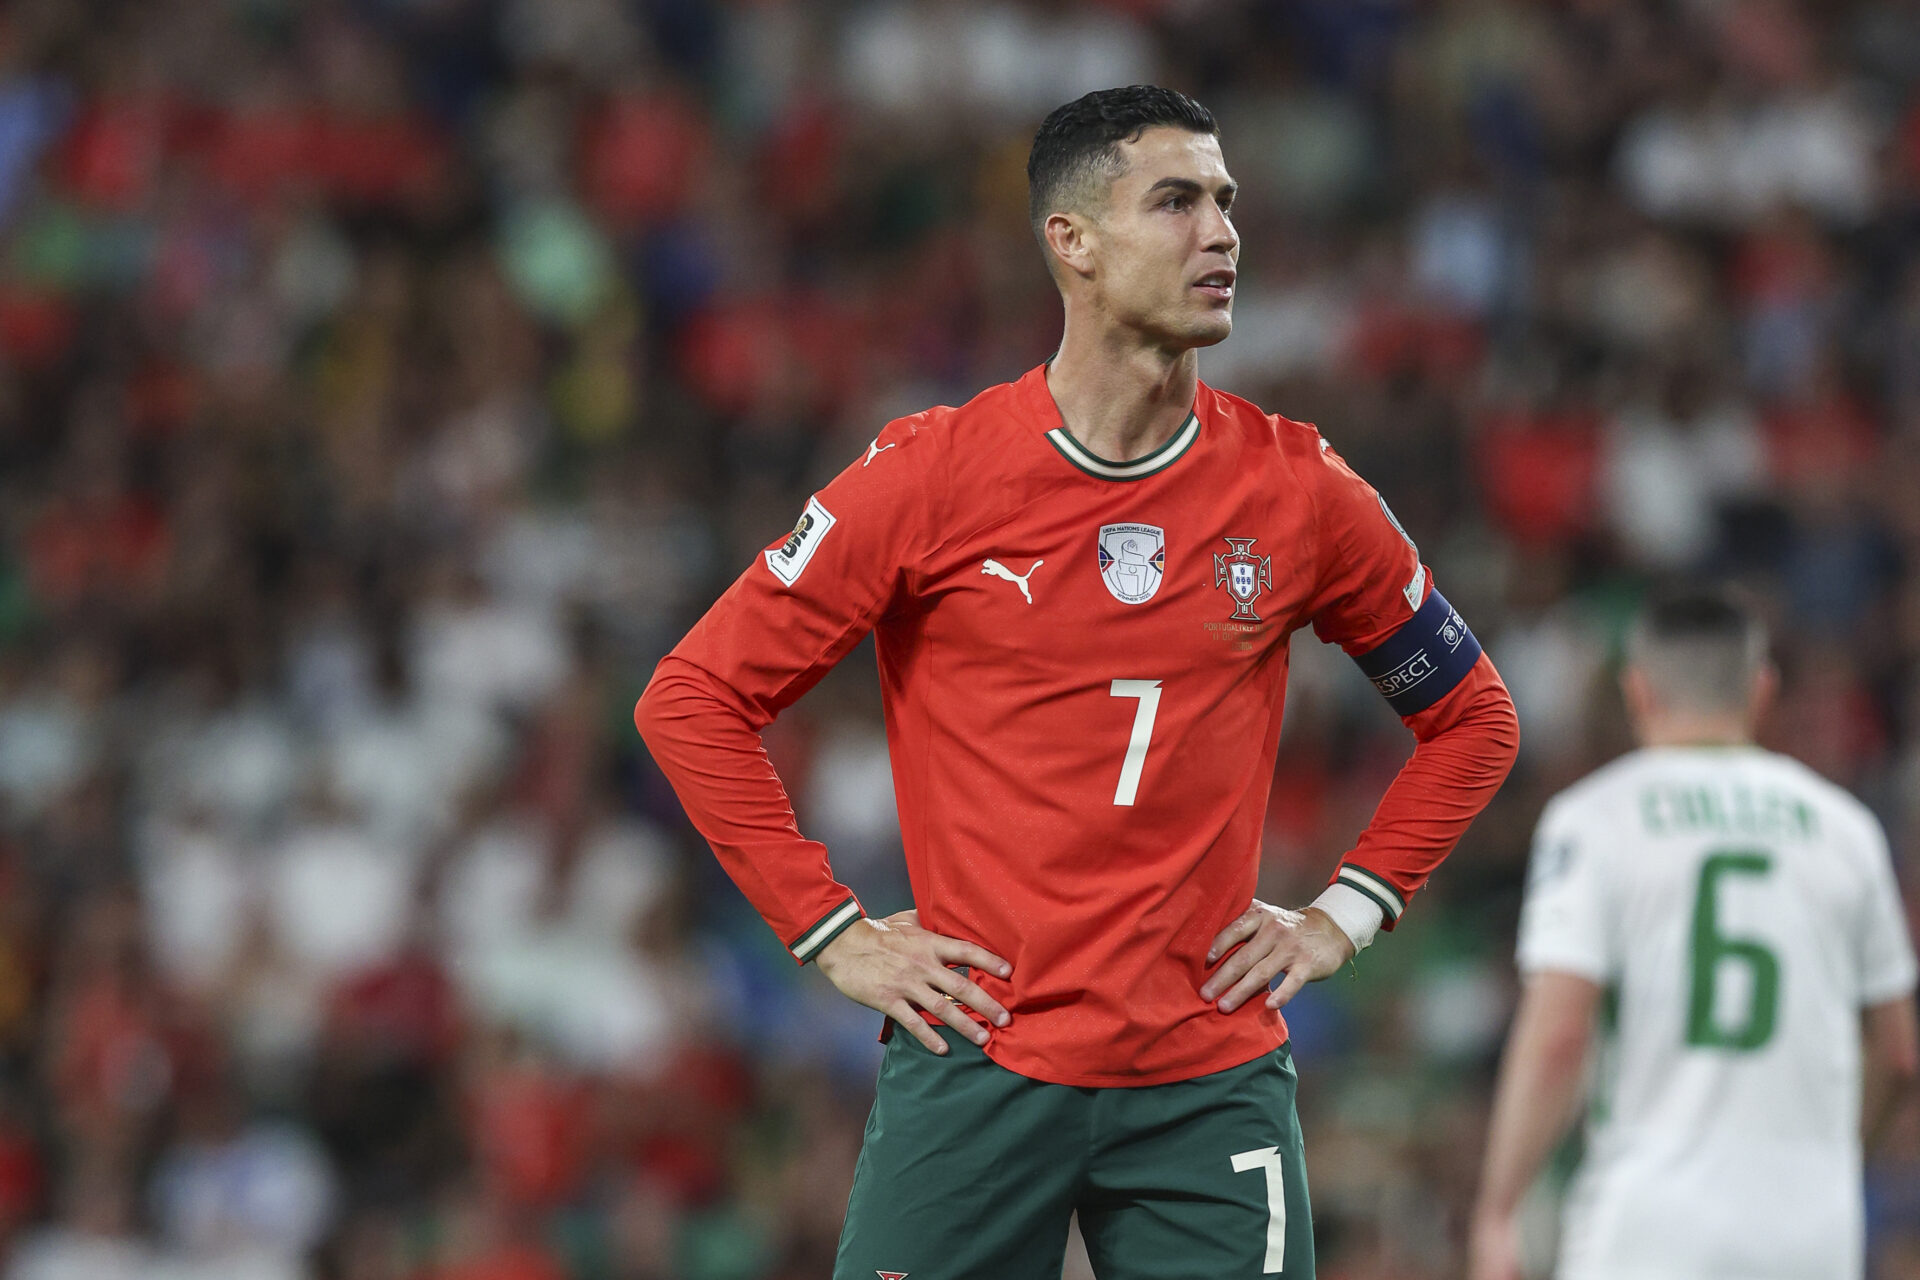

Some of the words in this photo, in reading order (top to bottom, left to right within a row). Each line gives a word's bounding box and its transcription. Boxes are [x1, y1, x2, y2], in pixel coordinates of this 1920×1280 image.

[1375, 653, 1431, 693] ESPECT
[1109, 679, 1163, 806] 7
[1685, 849, 1783, 1052] 6
[1229, 1145, 1287, 1275] 7
